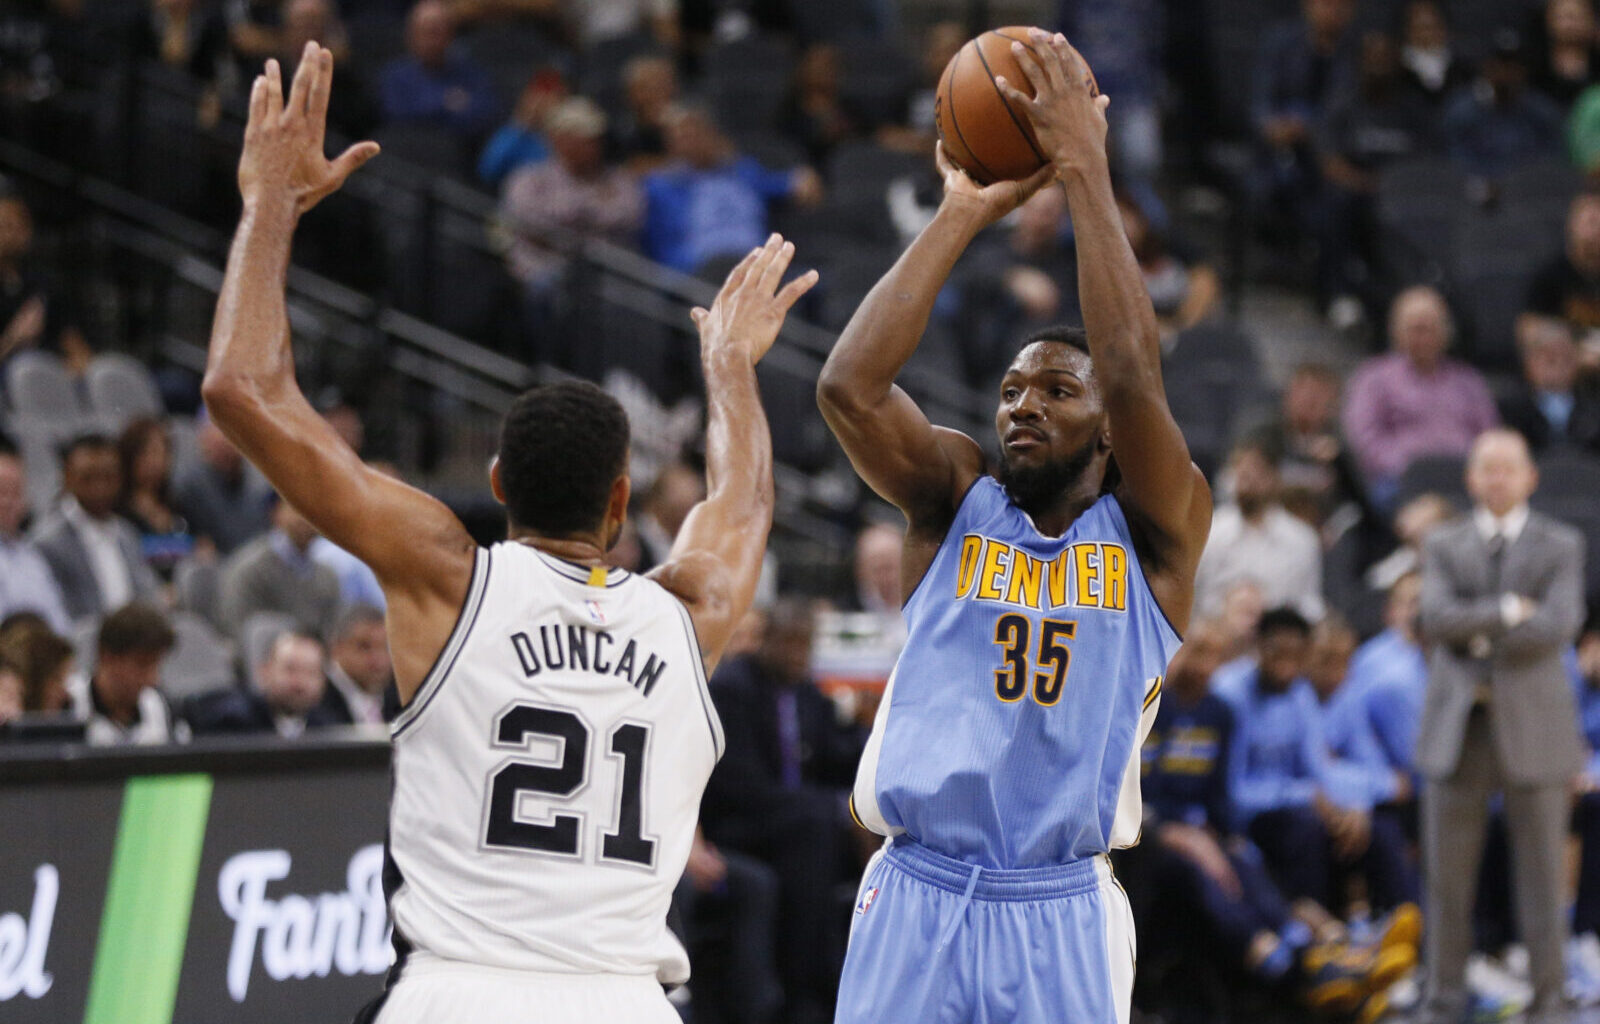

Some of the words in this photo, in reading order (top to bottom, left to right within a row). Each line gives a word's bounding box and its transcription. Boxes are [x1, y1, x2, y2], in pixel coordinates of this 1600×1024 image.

[957, 533, 1128, 612] DENVER
[510, 624, 667, 698] DUNCAN
[993, 612, 1078, 707] 35
[477, 698, 661, 876] 21
